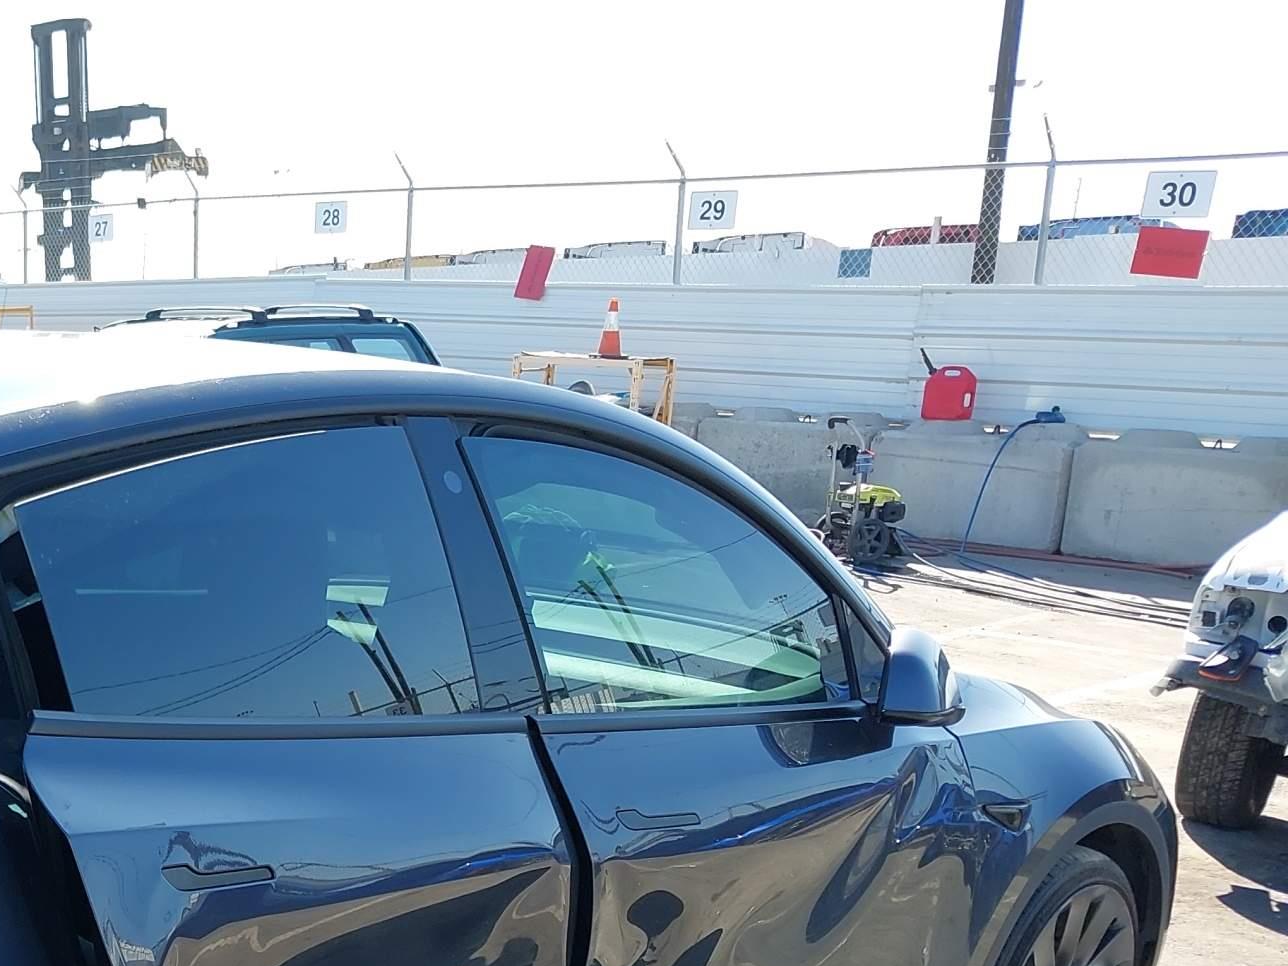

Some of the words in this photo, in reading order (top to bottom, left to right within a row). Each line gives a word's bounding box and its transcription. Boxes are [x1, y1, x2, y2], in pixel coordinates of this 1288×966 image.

[1159, 181, 1198, 208] 30
[322, 208, 340, 226] 28
[699, 199, 726, 221] 29
[94, 221, 108, 237] 27
